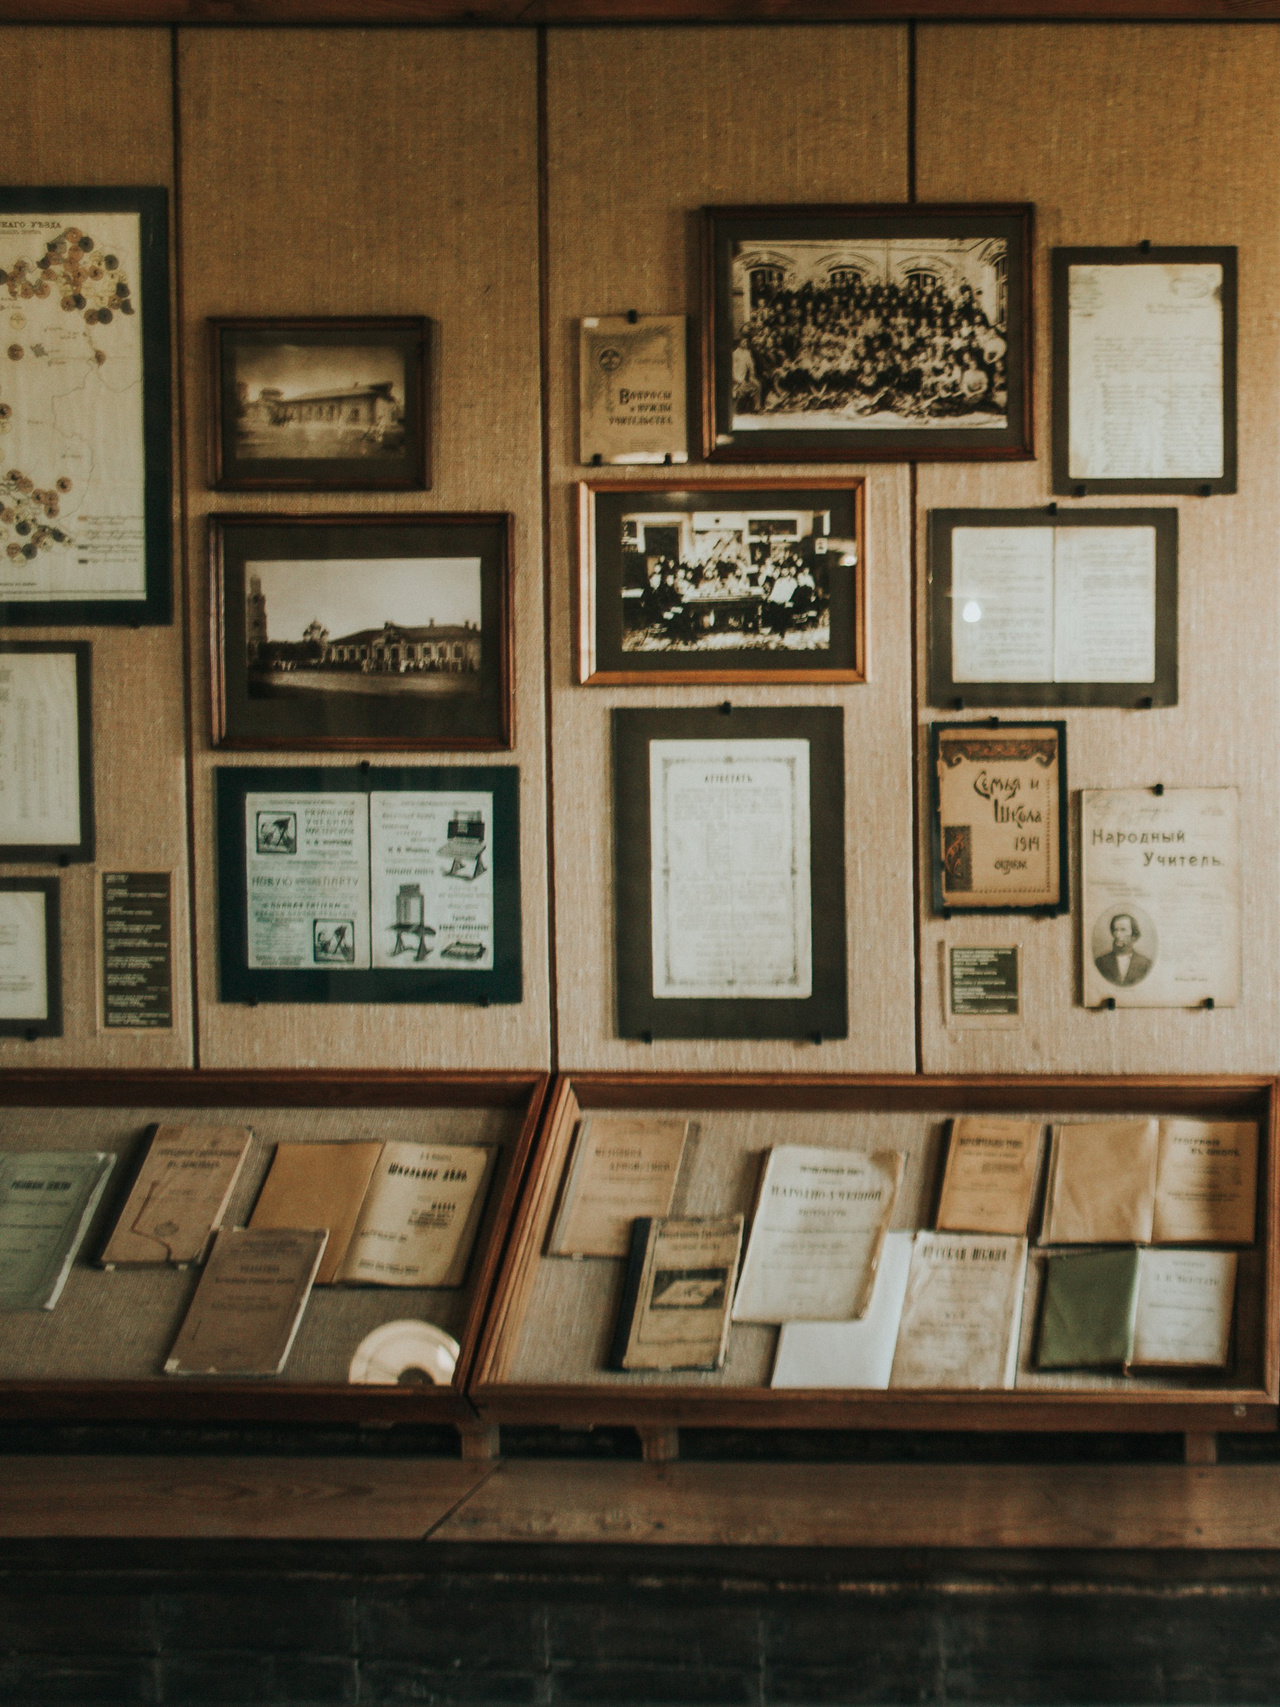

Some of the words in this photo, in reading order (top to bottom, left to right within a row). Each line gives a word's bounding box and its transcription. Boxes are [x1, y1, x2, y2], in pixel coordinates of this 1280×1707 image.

[973, 770, 1021, 800] Семья
[1030, 778, 1040, 790] и
[994, 799, 1043, 829] Школа
[1015, 836, 1040, 851] 1914
[1092, 829, 1186, 847] Народный
